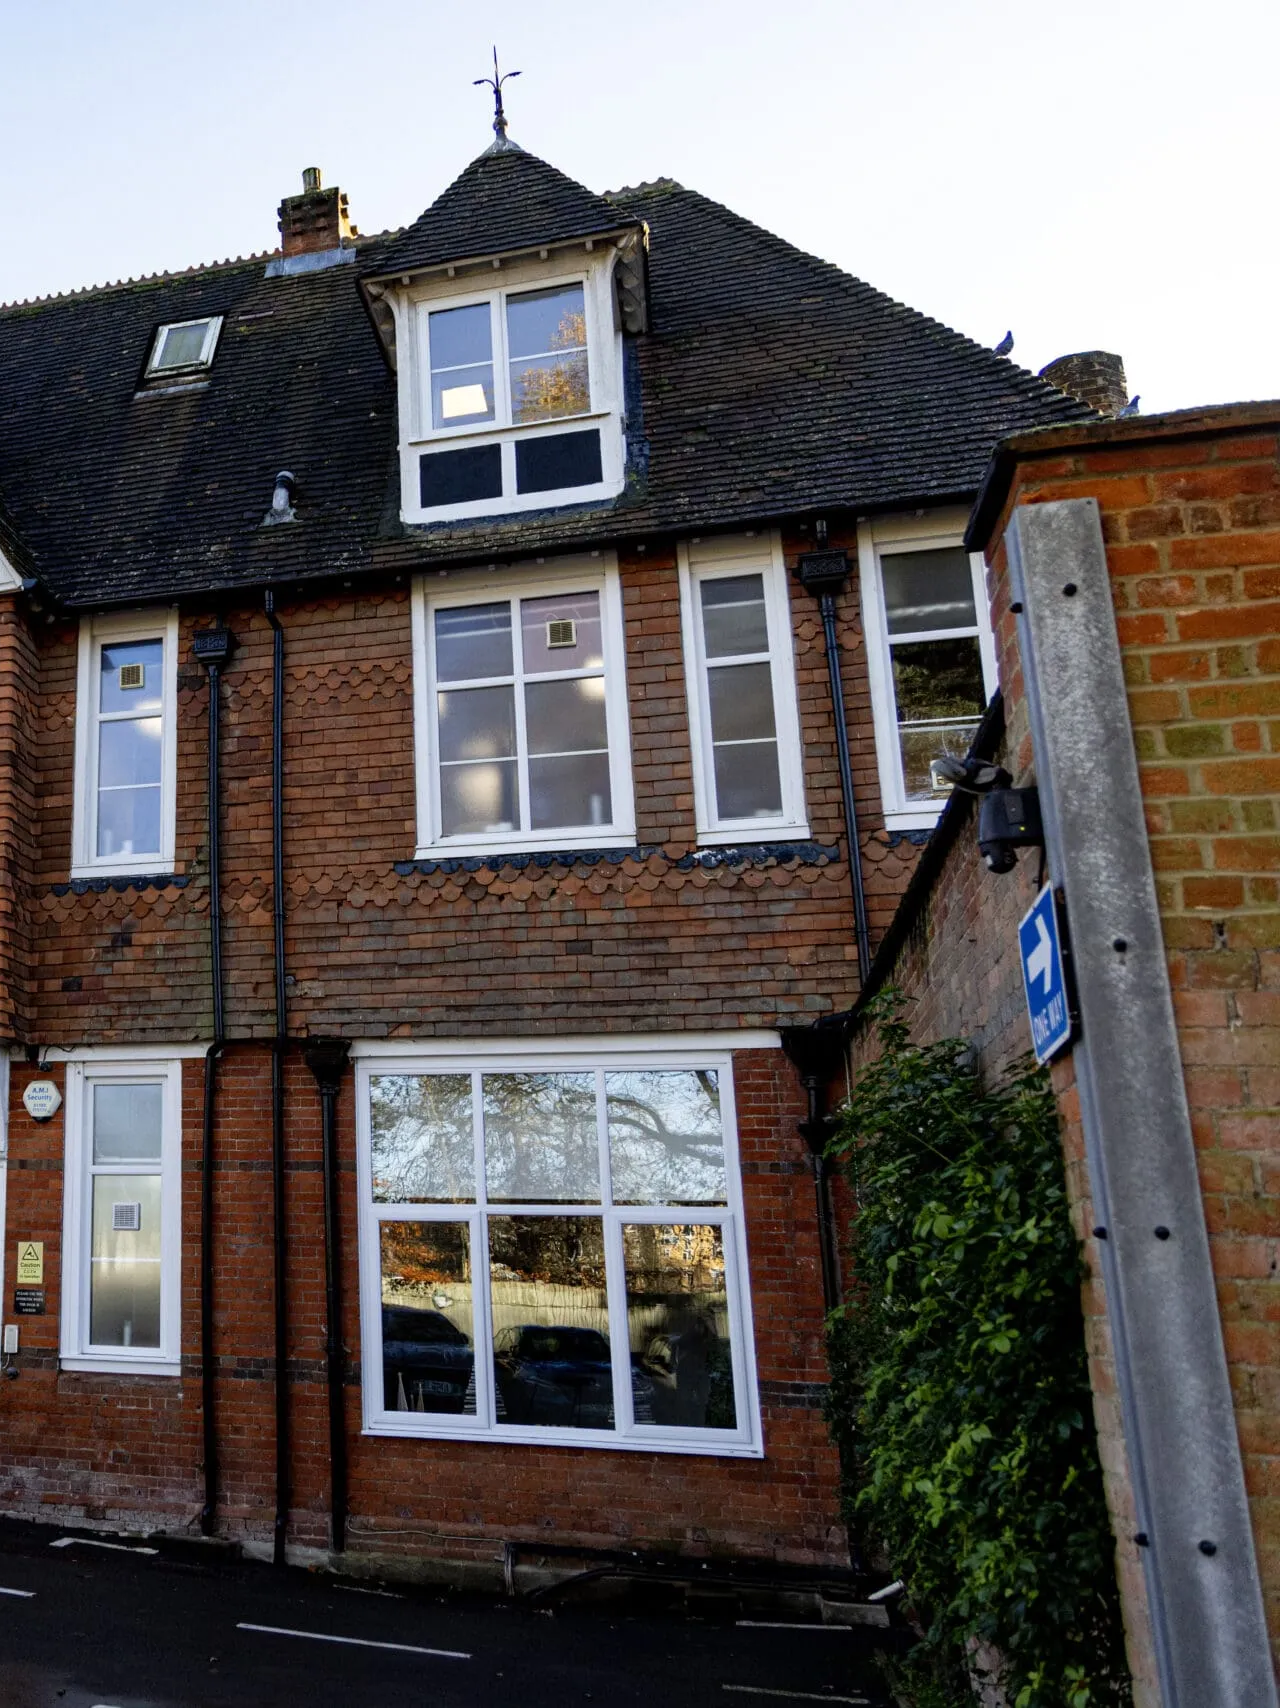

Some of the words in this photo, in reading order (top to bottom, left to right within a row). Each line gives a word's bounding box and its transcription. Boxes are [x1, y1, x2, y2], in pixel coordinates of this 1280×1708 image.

[1033, 1008, 1050, 1045] ONE
[1048, 990, 1064, 1031] WAY
[27, 1094, 52, 1102] Security
